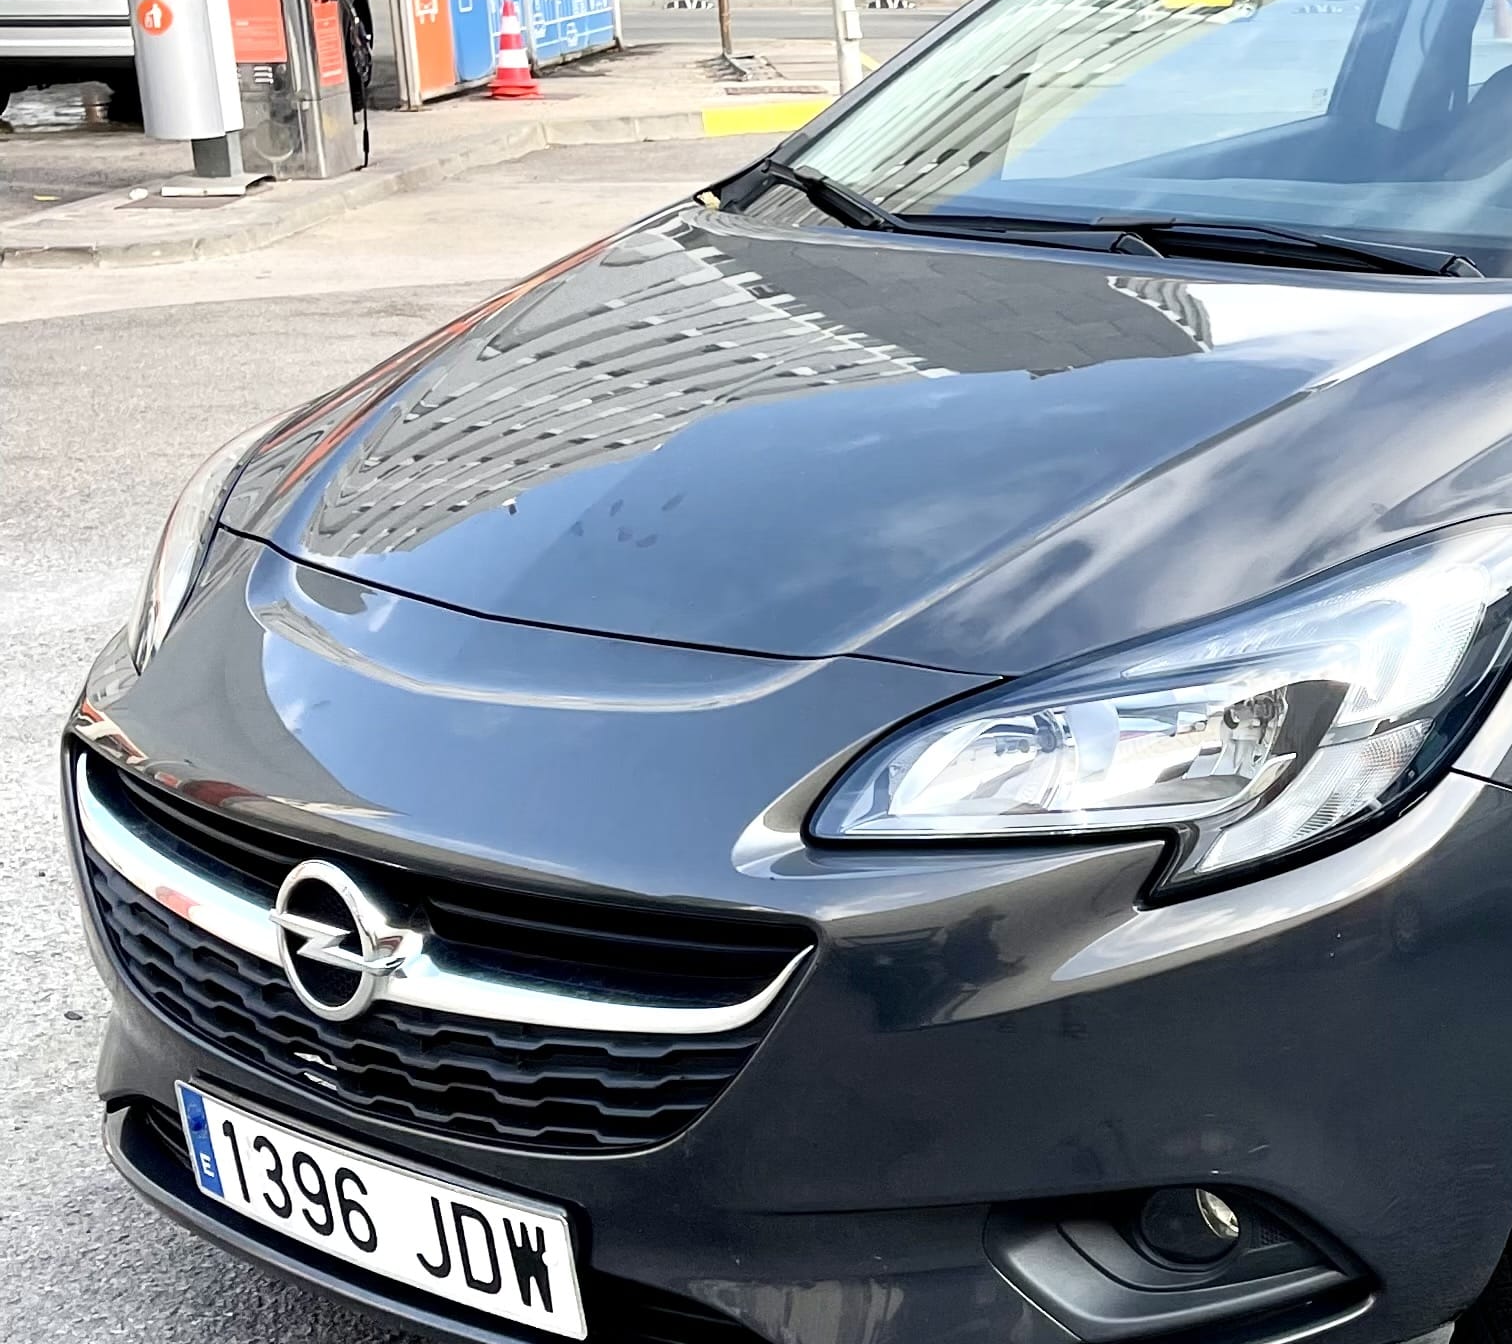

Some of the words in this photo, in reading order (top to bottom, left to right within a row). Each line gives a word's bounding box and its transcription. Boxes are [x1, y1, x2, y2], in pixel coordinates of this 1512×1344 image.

[199, 1152, 215, 1178] E
[222, 1119, 378, 1253] 1396
[416, 1196, 554, 1314] JDW
